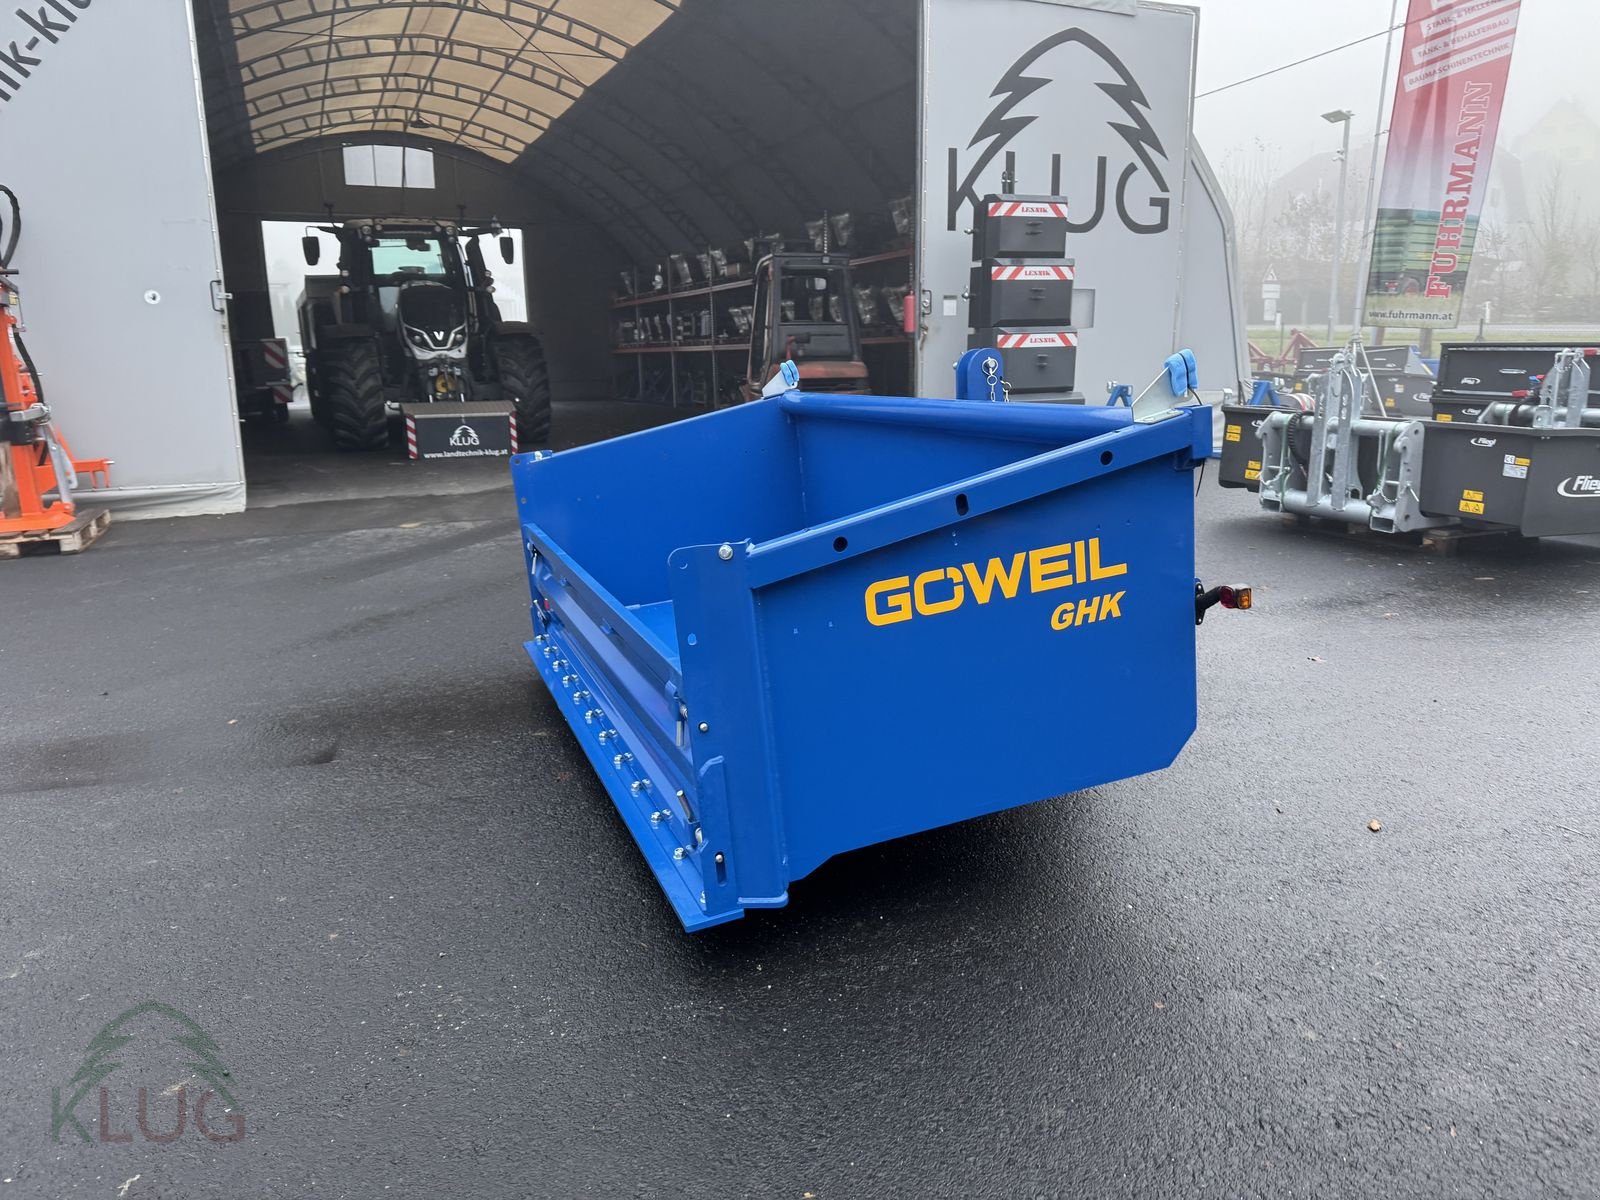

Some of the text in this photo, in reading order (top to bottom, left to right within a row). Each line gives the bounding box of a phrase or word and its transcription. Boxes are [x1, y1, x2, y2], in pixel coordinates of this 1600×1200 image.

[1408, 41, 1510, 85] BAUMASCHINENTECHNIK
[1425, 81, 1492, 299] FUHRMANN
[423, 448, 509, 459] www.landtechnik-klug.at
[449, 436, 479, 446] KLUG
[1050, 590, 1127, 631] GHK
